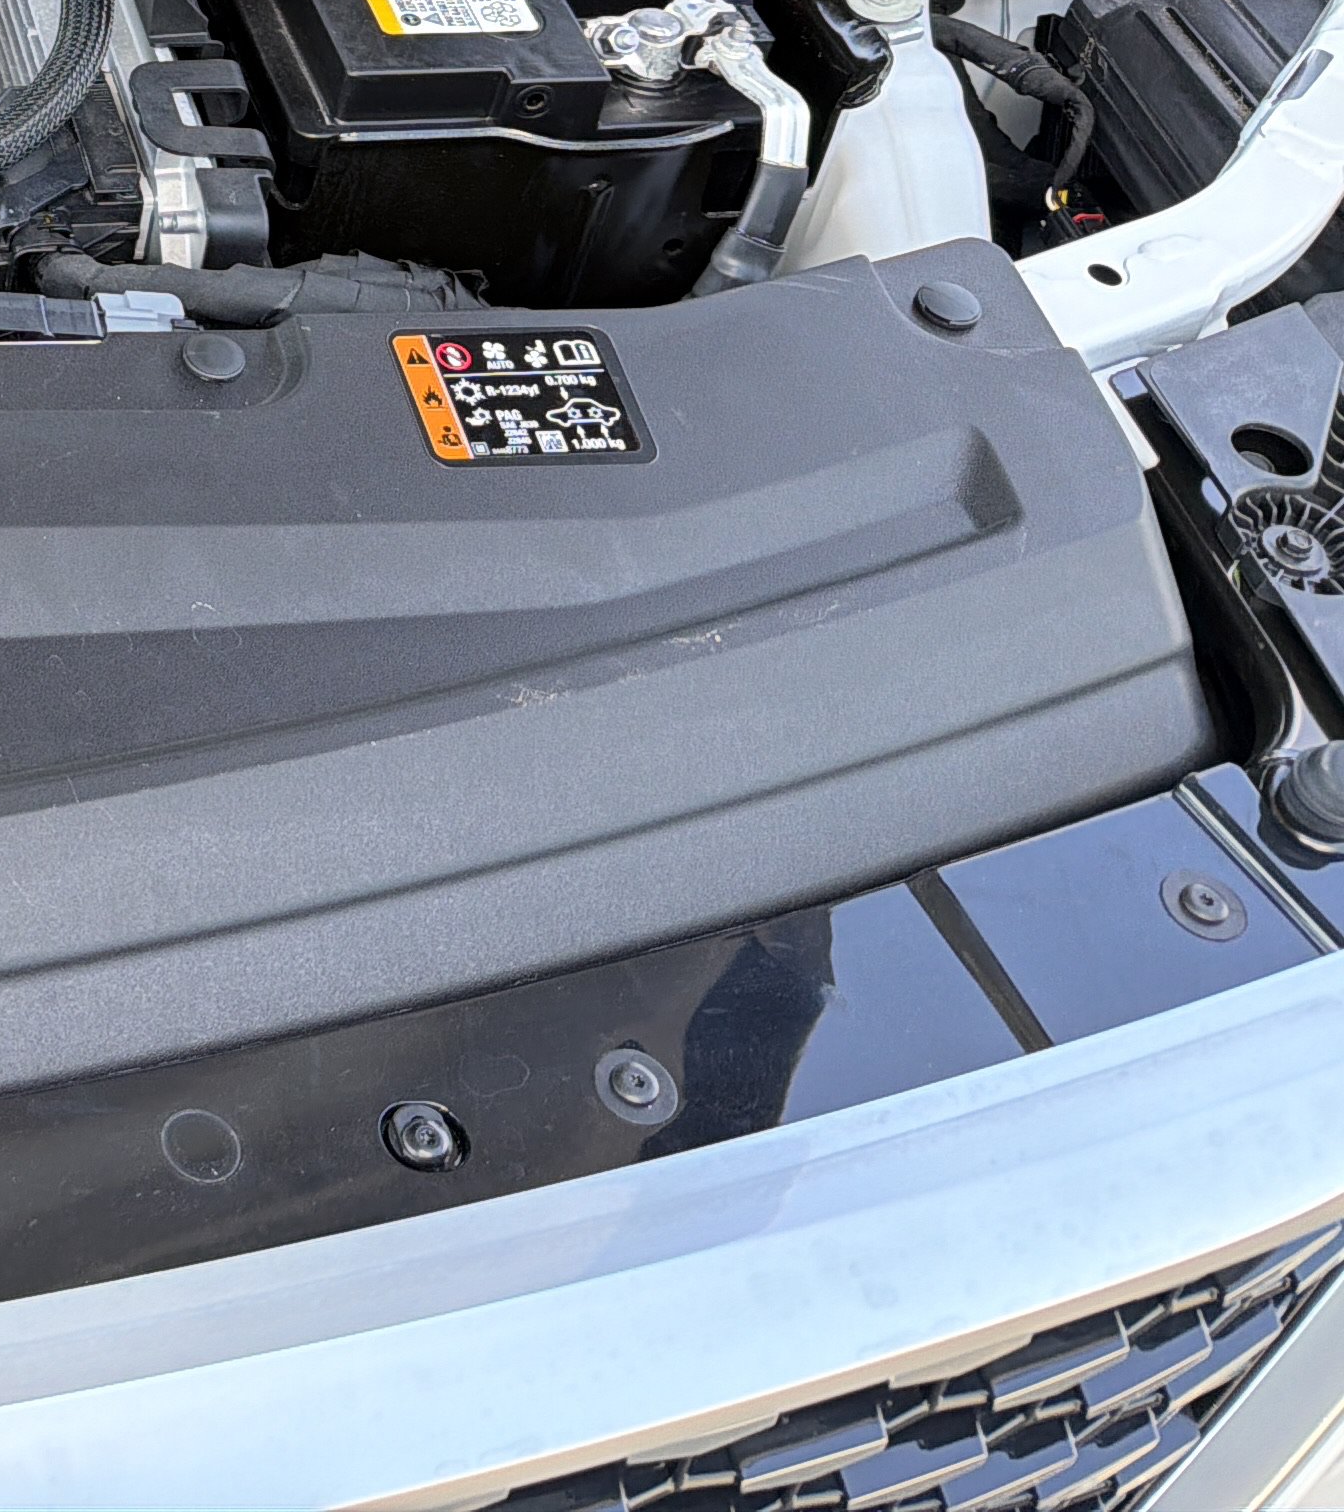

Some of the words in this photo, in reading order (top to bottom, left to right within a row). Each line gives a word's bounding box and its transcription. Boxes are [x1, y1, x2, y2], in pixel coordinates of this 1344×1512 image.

[487, 360, 514, 370] AUTO
[545, 375, 578, 386] 0.700
[579, 374, 597, 386] kg
[485, 384, 540, 397] R-1234yf
[495, 409, 523, 421] PAG
[571, 438, 607, 449] 1.000
[607, 438, 626, 450] kg
